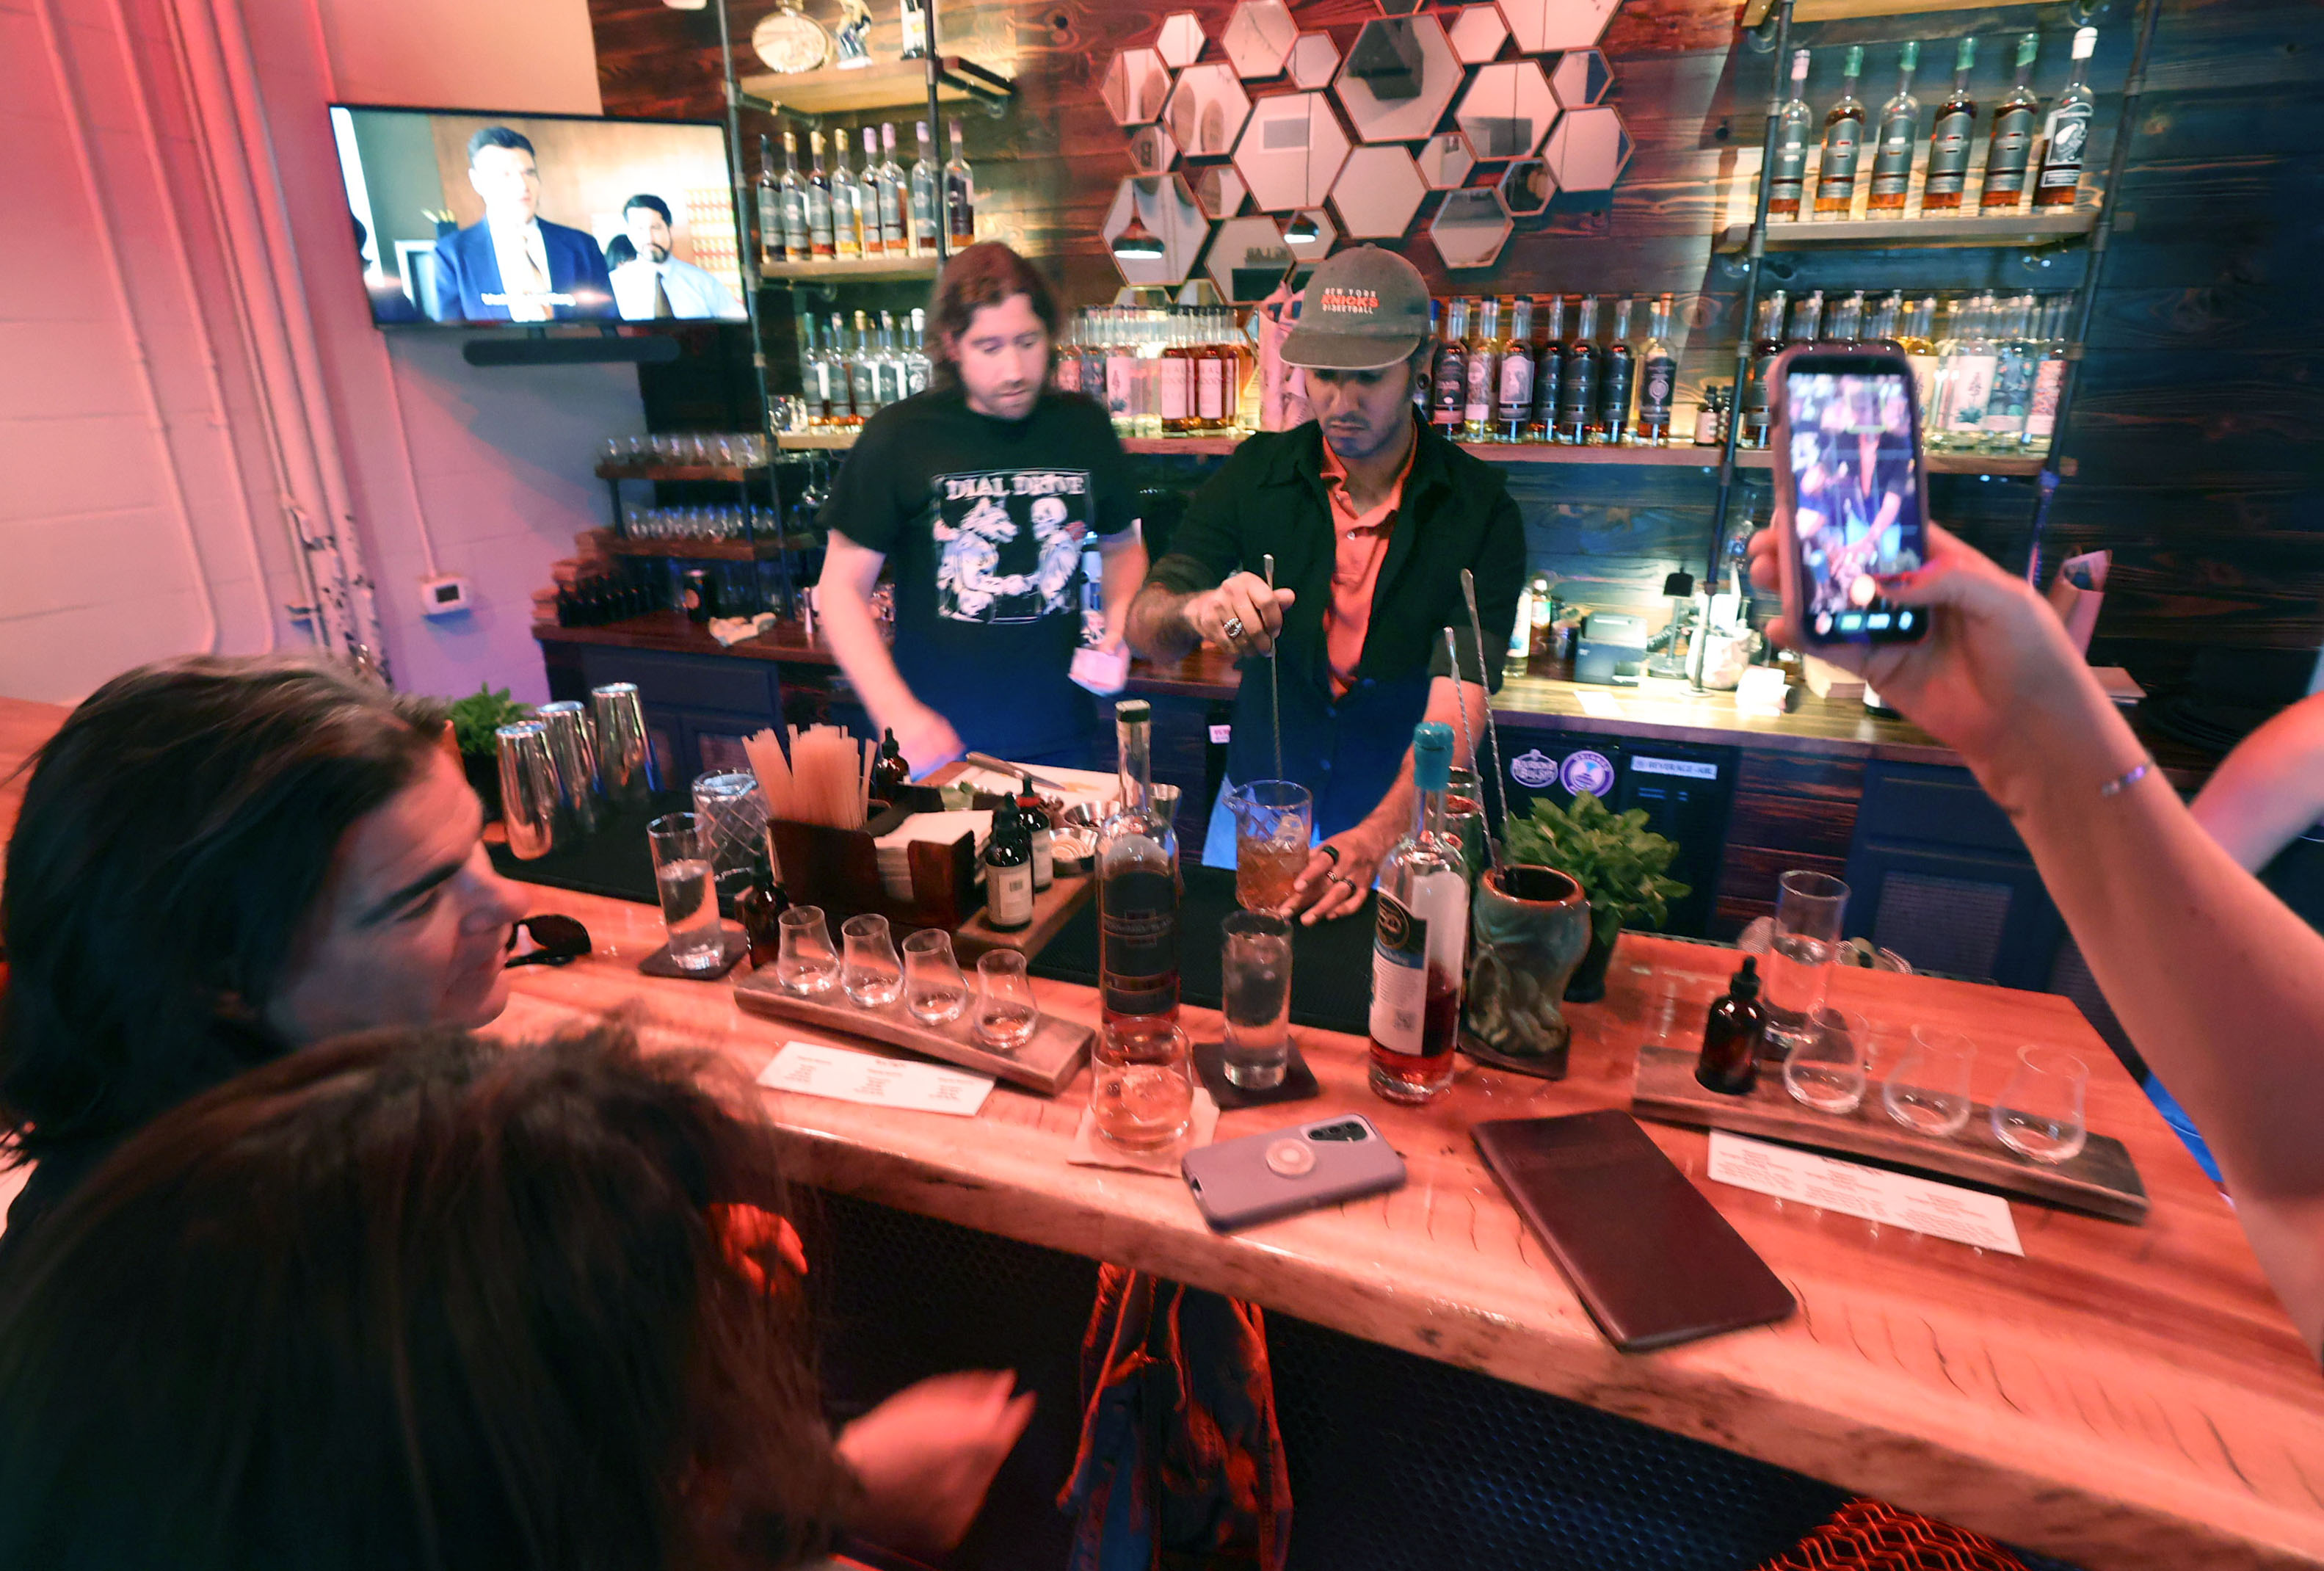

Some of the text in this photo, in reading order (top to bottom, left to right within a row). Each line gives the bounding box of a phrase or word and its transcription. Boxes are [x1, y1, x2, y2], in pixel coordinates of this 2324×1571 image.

[1324, 287, 1376, 298] NEW YORK
[1321, 294, 1379, 308] KNICKS
[945, 477, 1011, 500] DIAL
